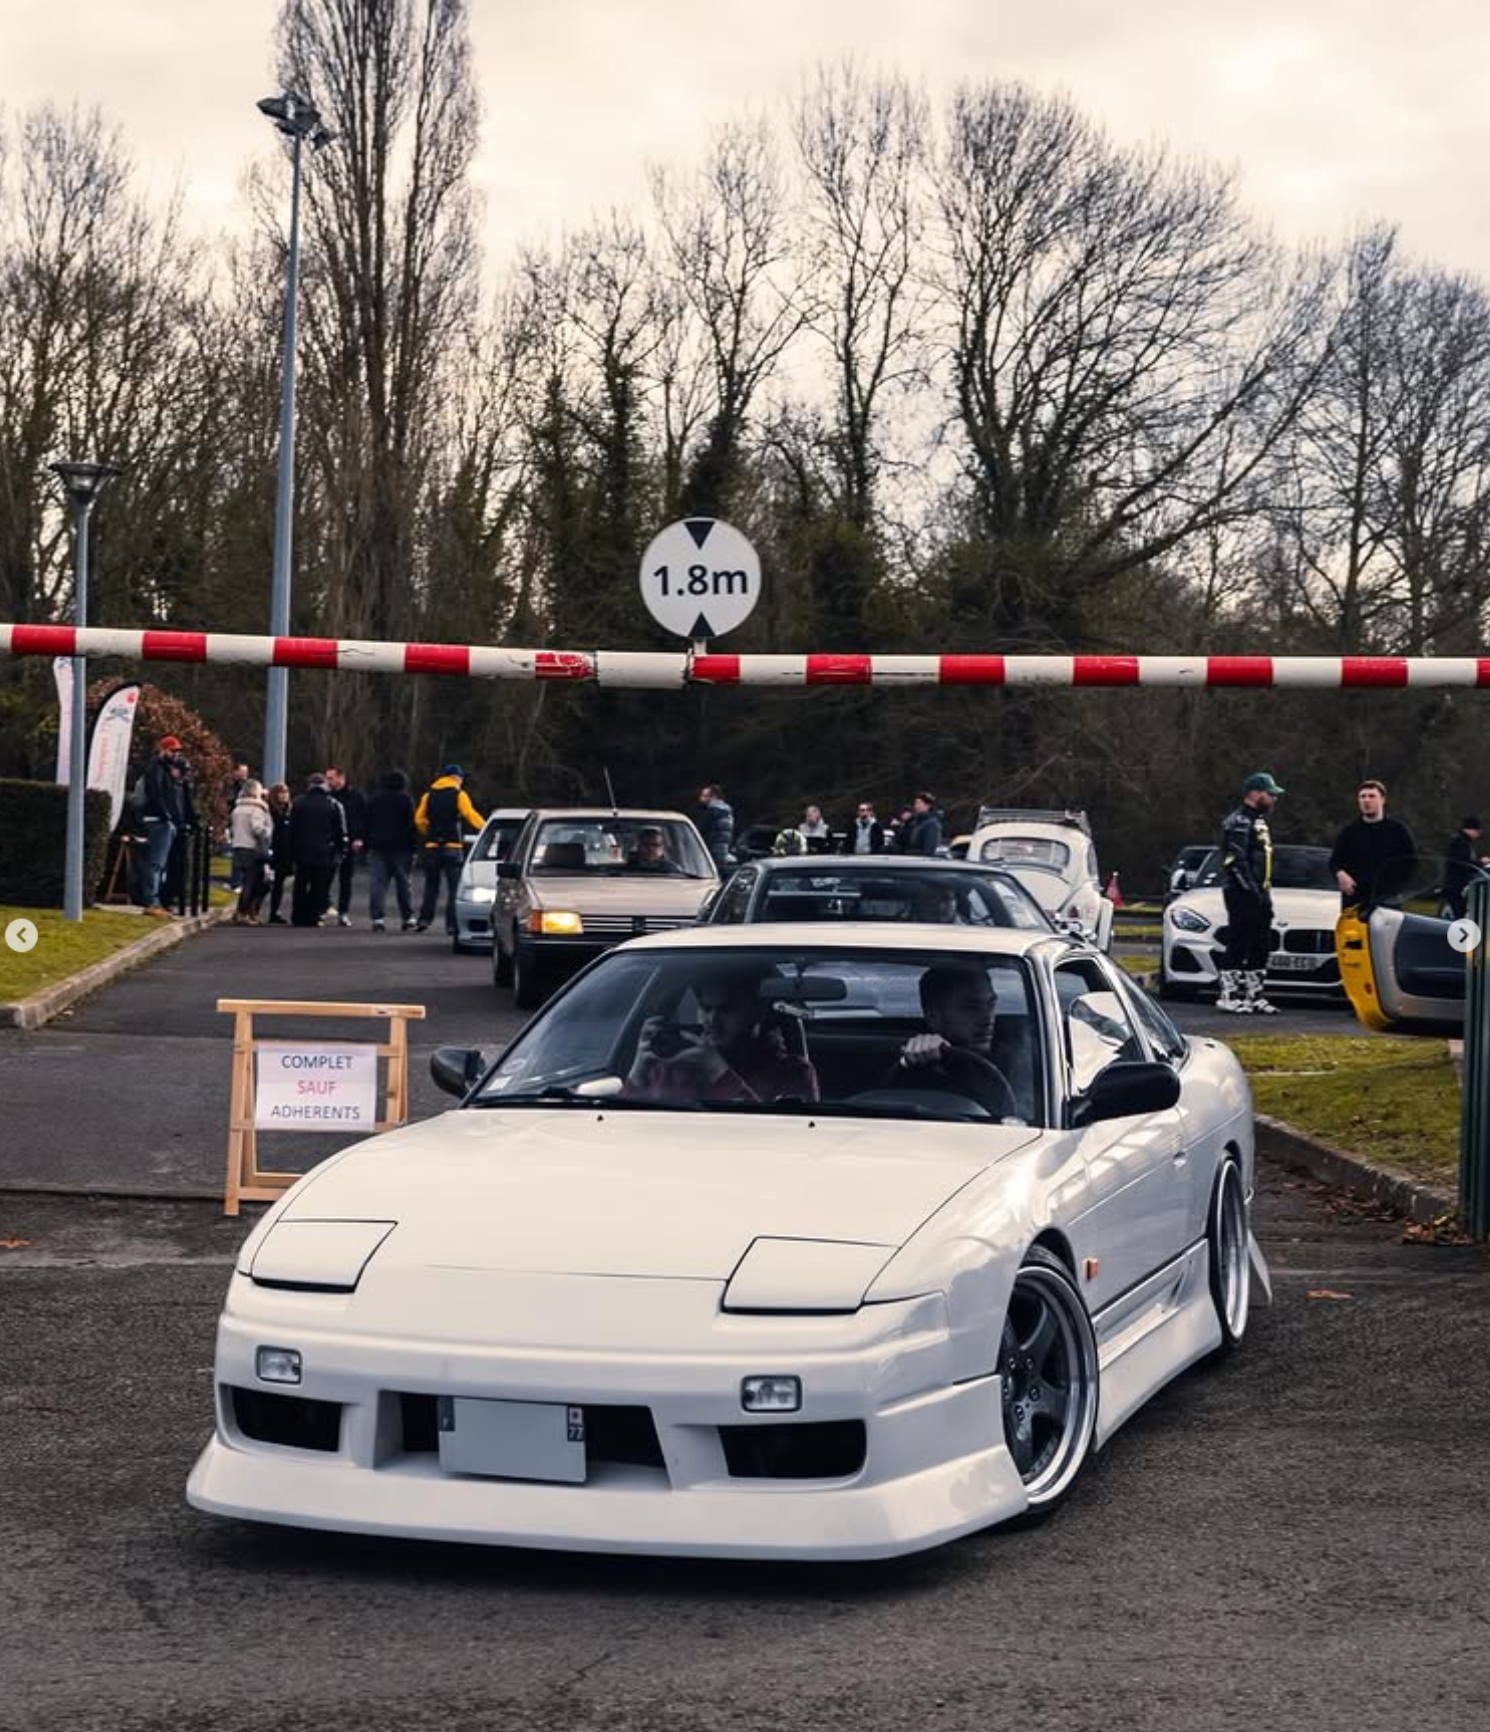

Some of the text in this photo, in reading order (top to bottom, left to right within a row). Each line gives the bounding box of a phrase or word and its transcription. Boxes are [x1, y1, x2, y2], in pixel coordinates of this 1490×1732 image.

[653, 564, 748, 596] 1.8m
[281, 1055, 353, 1069] COMPLET
[298, 1081, 337, 1095] SAUF
[270, 1105, 360, 1119] ADHERENTS
[568, 1426, 584, 1439] 77
